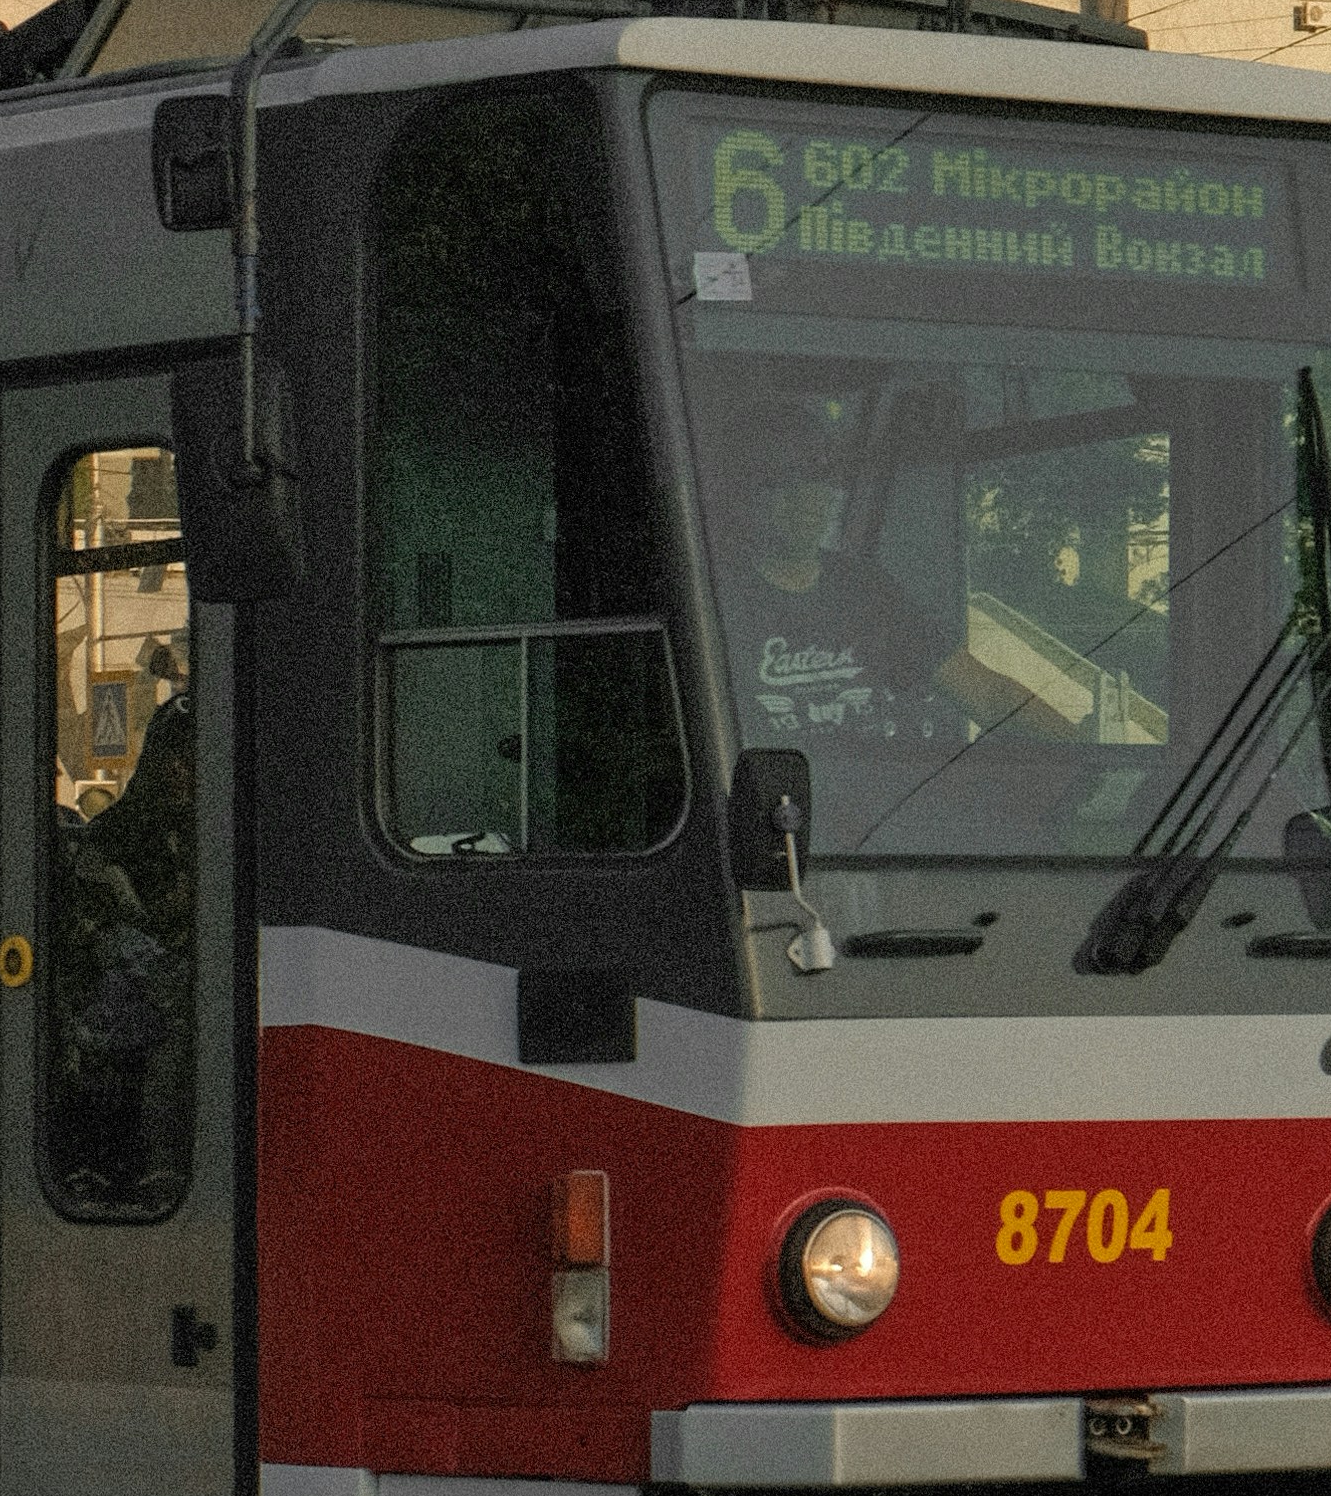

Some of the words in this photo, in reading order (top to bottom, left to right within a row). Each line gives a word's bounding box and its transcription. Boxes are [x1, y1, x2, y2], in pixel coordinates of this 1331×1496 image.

[713, 128, 785, 254] 6
[803, 138, 910, 194] 602
[931, 146, 1265, 218] Мікрорайон
[1096, 224, 1265, 280] Вокзал
[995, 1188, 1173, 1266] 8704
